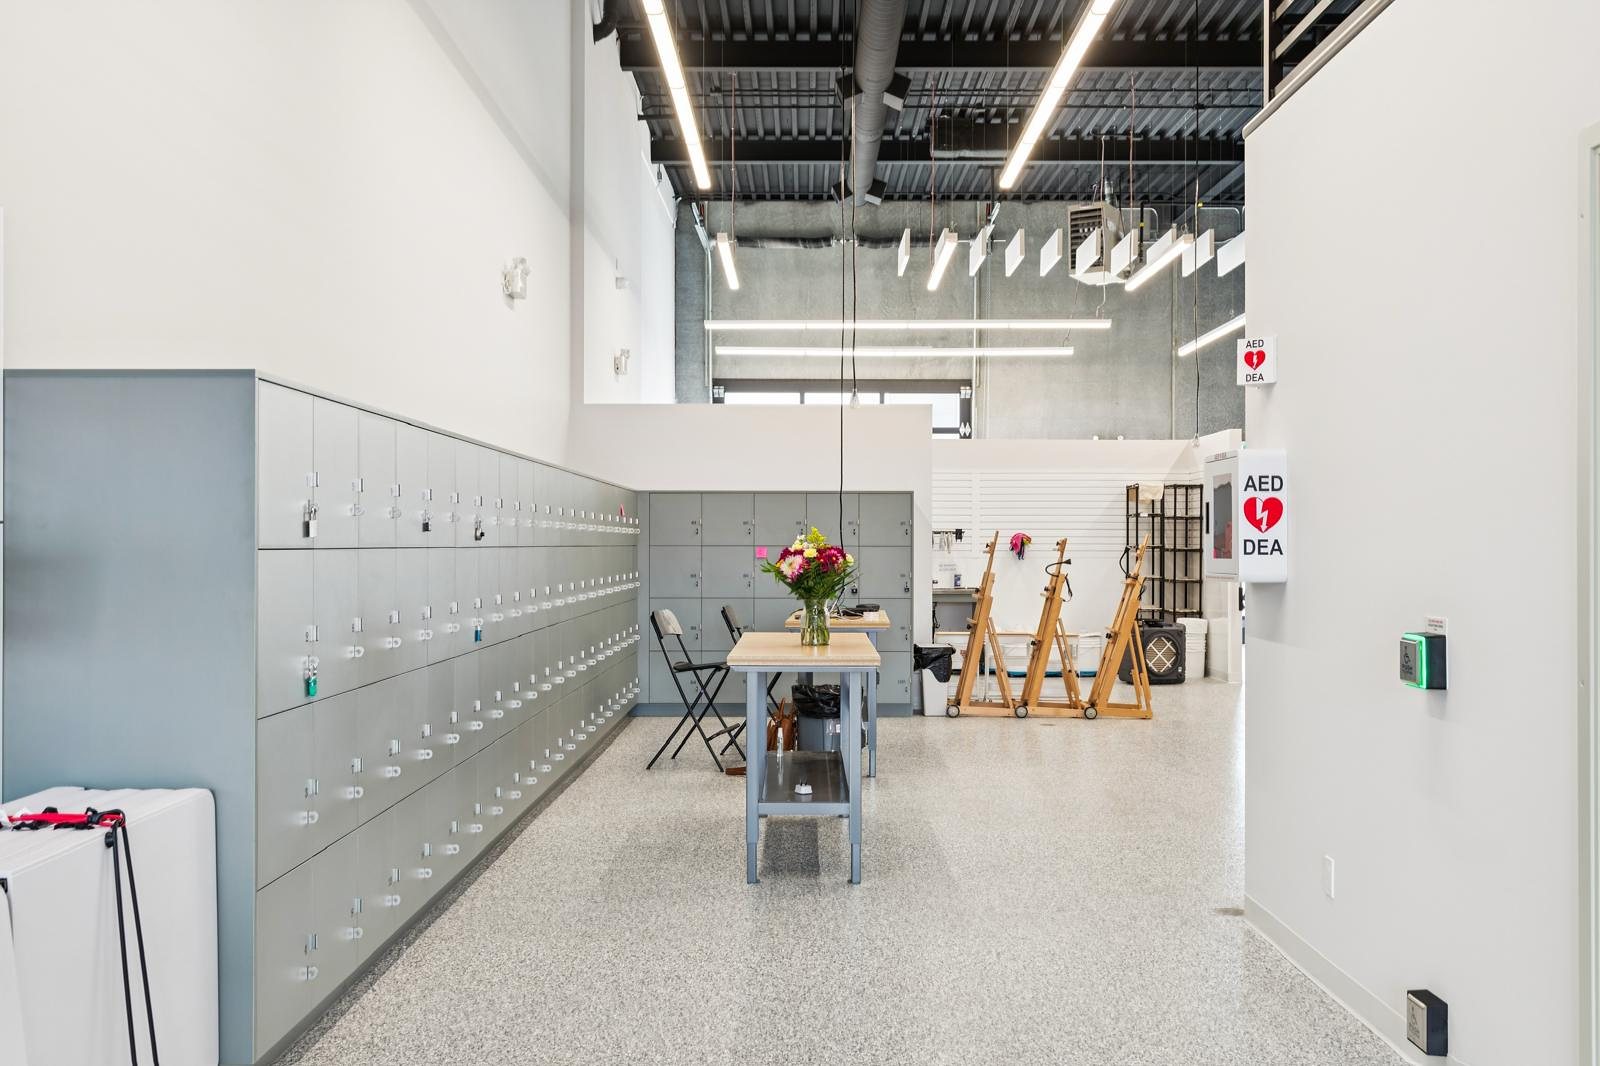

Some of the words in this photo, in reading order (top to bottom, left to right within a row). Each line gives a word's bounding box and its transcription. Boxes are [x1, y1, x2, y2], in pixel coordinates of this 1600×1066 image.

[1245, 339, 1264, 348] AED
[1245, 373, 1264, 382] DEA
[1244, 475, 1284, 492] AED
[1244, 539, 1284, 556] DEA
